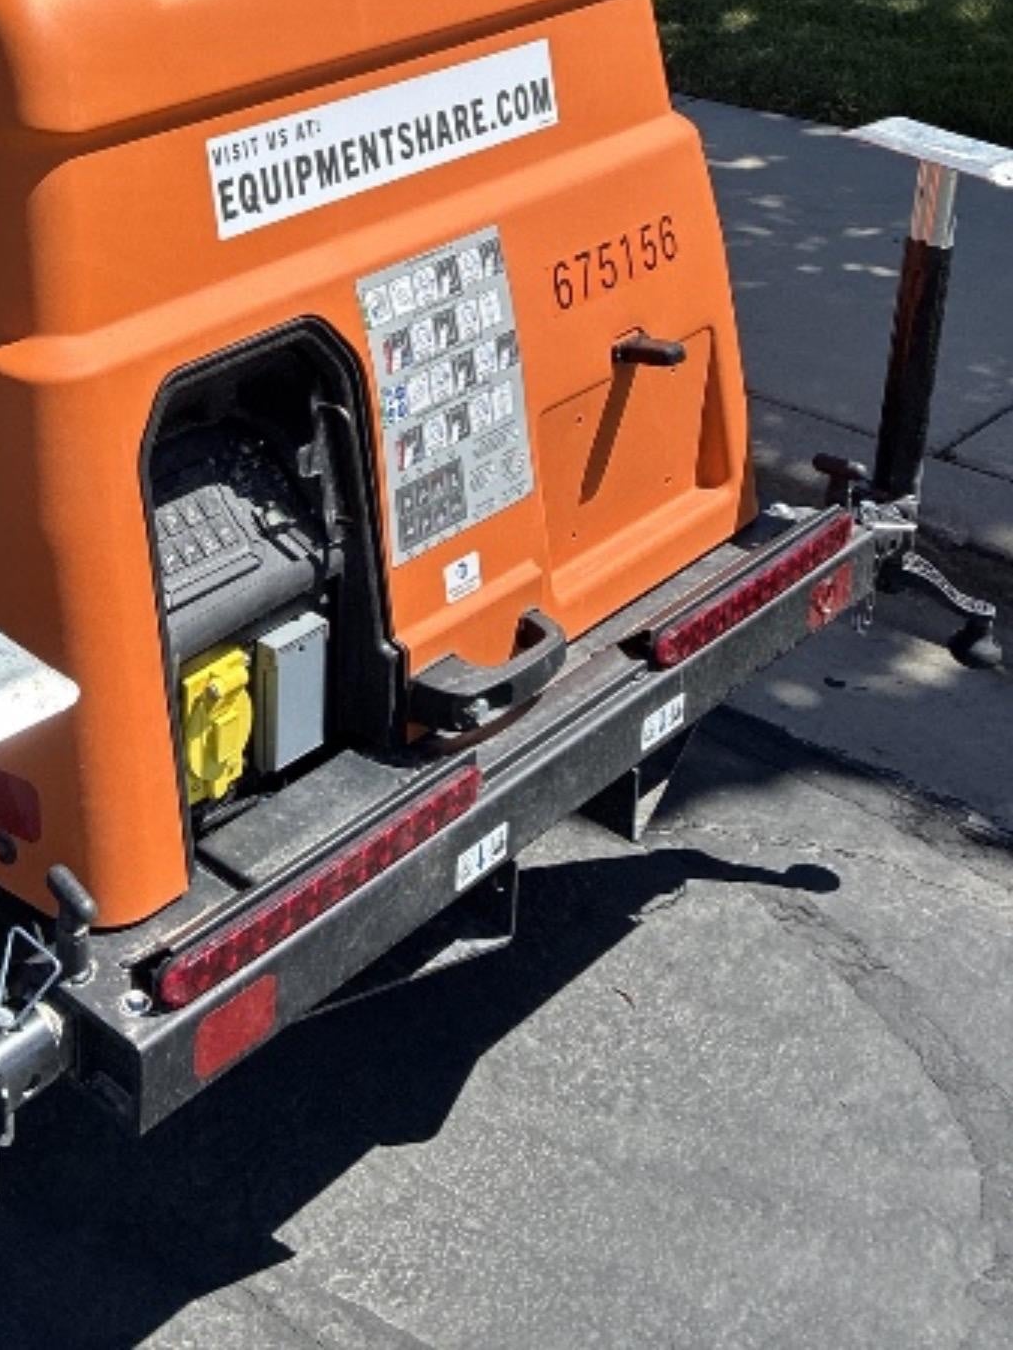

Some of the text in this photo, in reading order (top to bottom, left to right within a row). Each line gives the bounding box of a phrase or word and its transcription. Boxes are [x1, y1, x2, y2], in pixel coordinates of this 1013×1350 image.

[211, 136, 258, 166] VISIT
[265, 127, 289, 151] US
[218, 76, 553, 223] EQUIPMENTSHARE.COM
[553, 215, 678, 310] 675156
